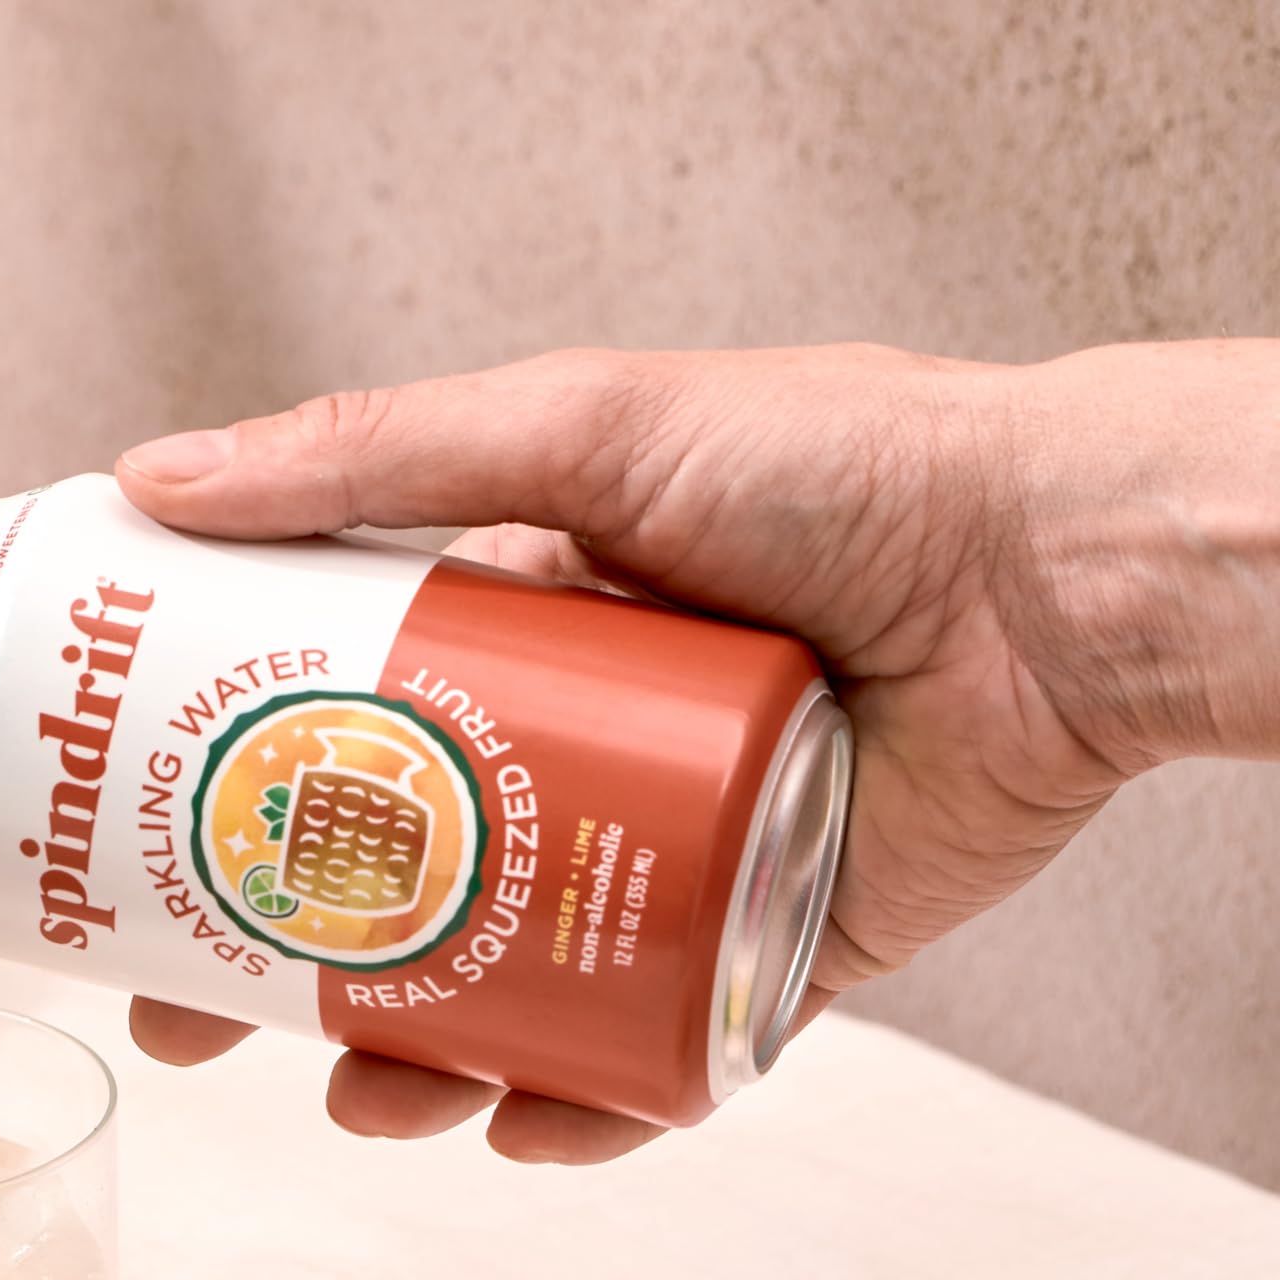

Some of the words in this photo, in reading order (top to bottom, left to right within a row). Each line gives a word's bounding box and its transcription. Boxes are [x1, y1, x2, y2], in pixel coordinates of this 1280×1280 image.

[168, 648, 330, 738] WATER
[401, 668, 512, 760] FRUIT
[20, 579, 155, 950] spindrift
[138, 750, 271, 977] SPARKLING
[452, 764, 540, 983] SQUEEZED
[551, 887, 580, 965] GINGER
[570, 817, 596, 866] LIME
[579, 822, 624, 974] non-alcoholic
[625, 875, 649, 909] (355
[632, 847, 657, 875] ML)
[613, 950, 634, 966] 12
[616, 933, 637, 949] FL
[619, 909, 641, 931] OZ
[345, 976, 457, 1009] REAL
